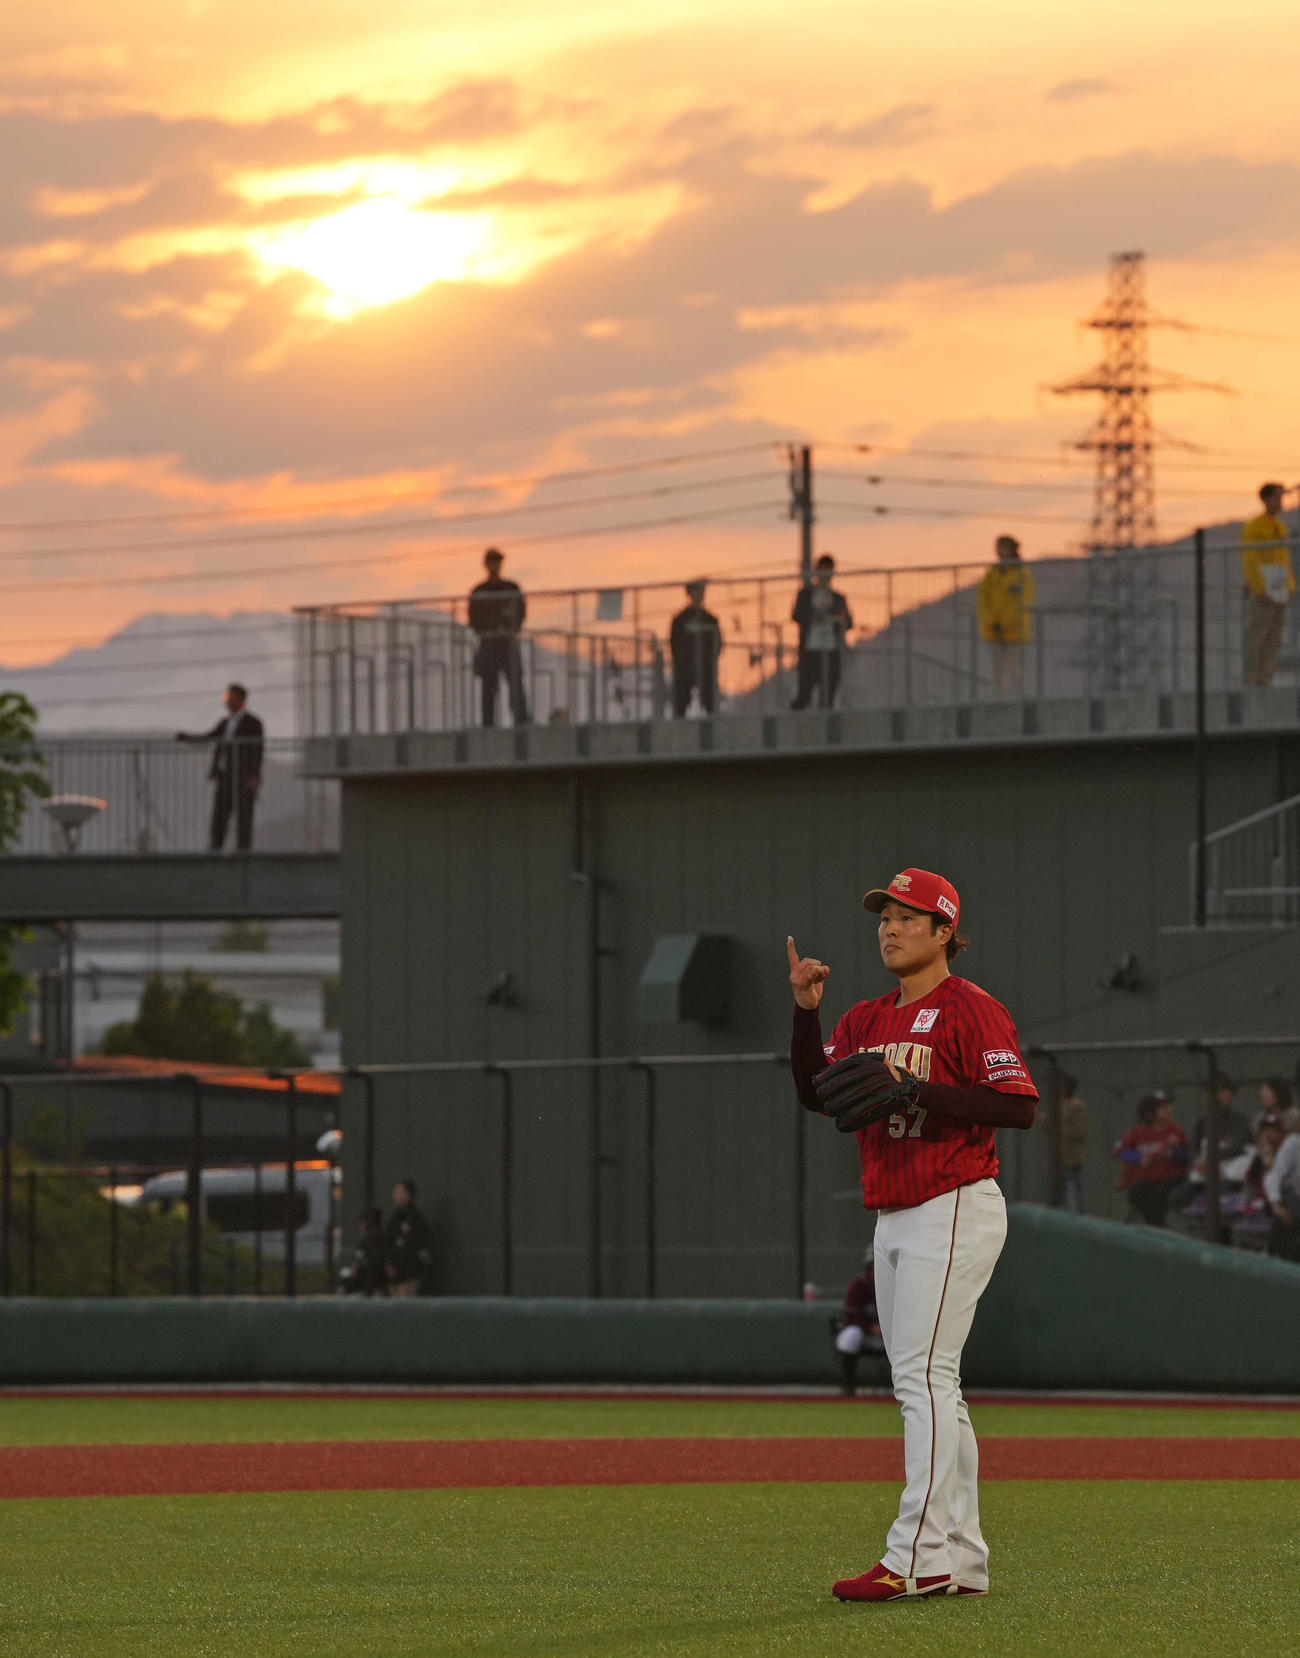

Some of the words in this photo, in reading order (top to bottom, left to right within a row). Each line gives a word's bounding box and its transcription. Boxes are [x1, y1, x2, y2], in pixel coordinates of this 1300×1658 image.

[858, 1042, 933, 1082] OKU
[986, 1052, 1018, 1065] やまや
[888, 1105, 928, 1138] 57
